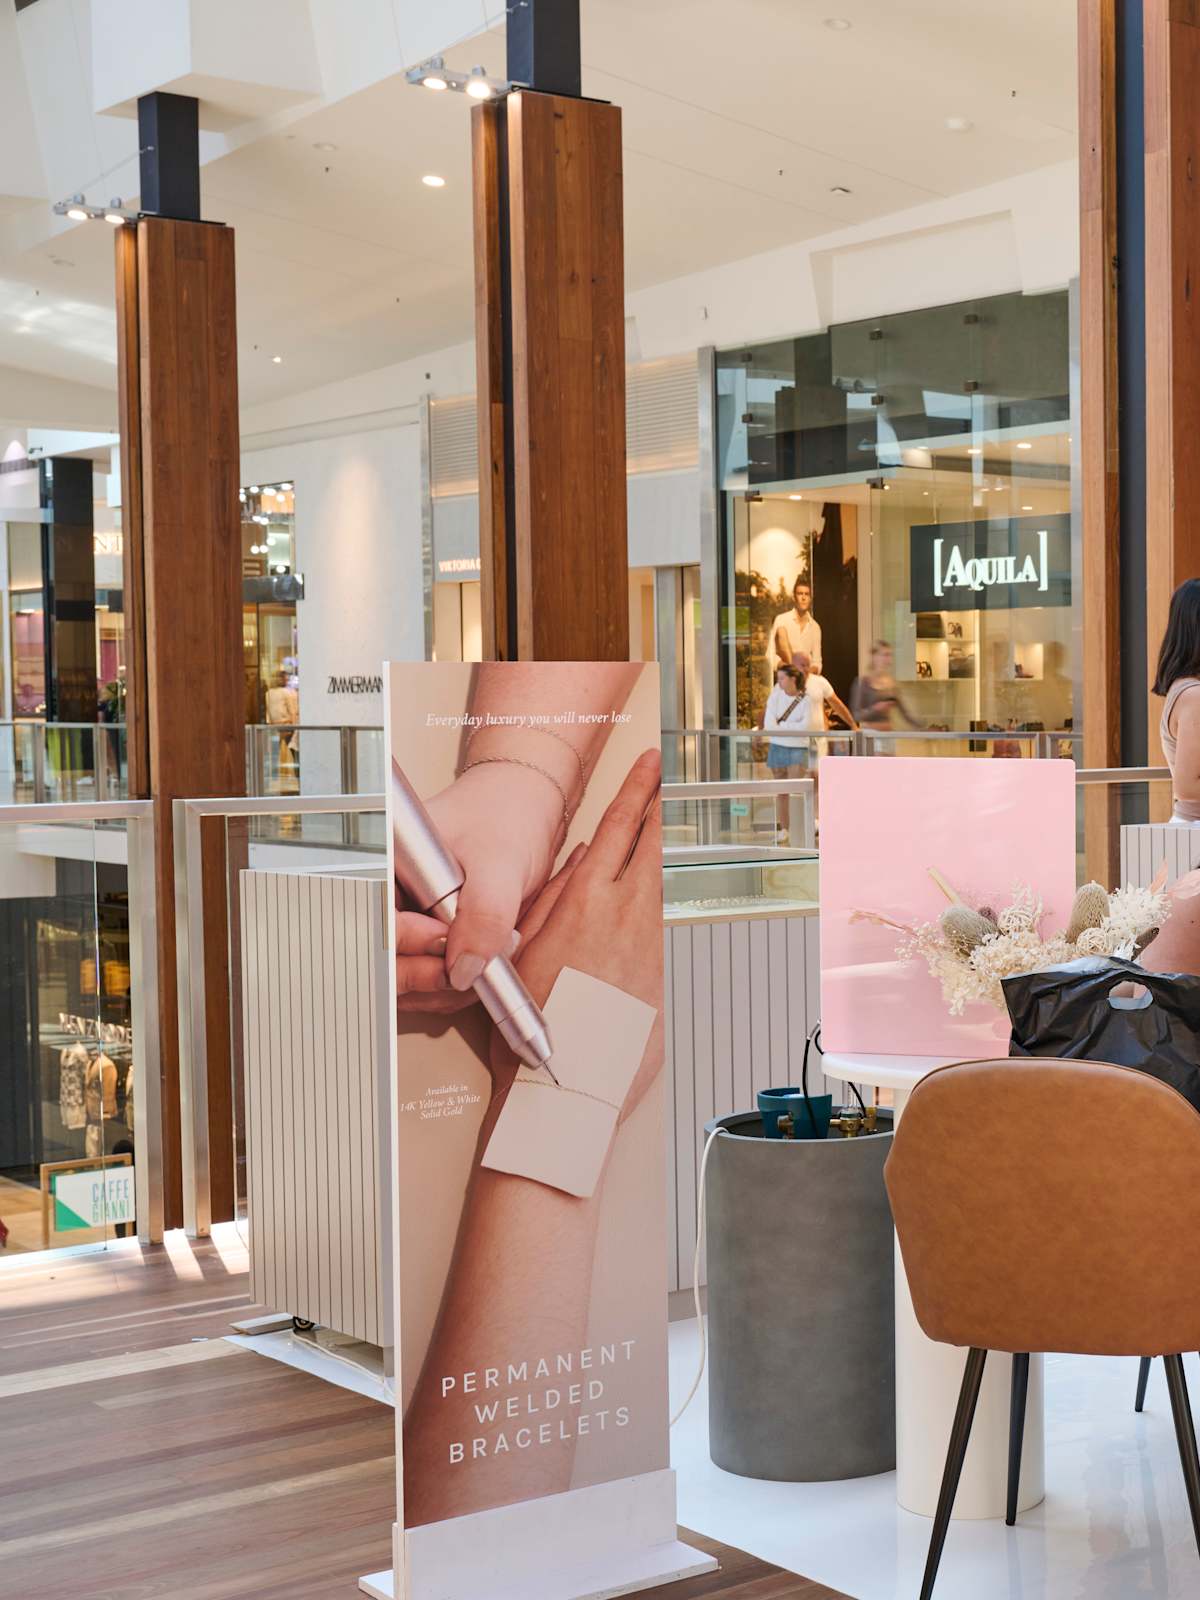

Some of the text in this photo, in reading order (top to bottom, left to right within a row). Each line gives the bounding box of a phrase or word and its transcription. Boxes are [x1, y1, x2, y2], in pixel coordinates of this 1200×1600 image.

[426, 711, 632, 728] Everyday luxury you will never lose
[426, 1084, 458, 1097] Available
[420, 1098, 446, 1109] Yellow
[447, 1097, 455, 1106] &
[457, 1094, 480, 1105] White
[420, 1105, 463, 1119] Solid Gold
[441, 1340, 636, 1397] PERMANENT
[474, 1380, 604, 1424] WELDED
[450, 1407, 630, 1464] BRACELETS
